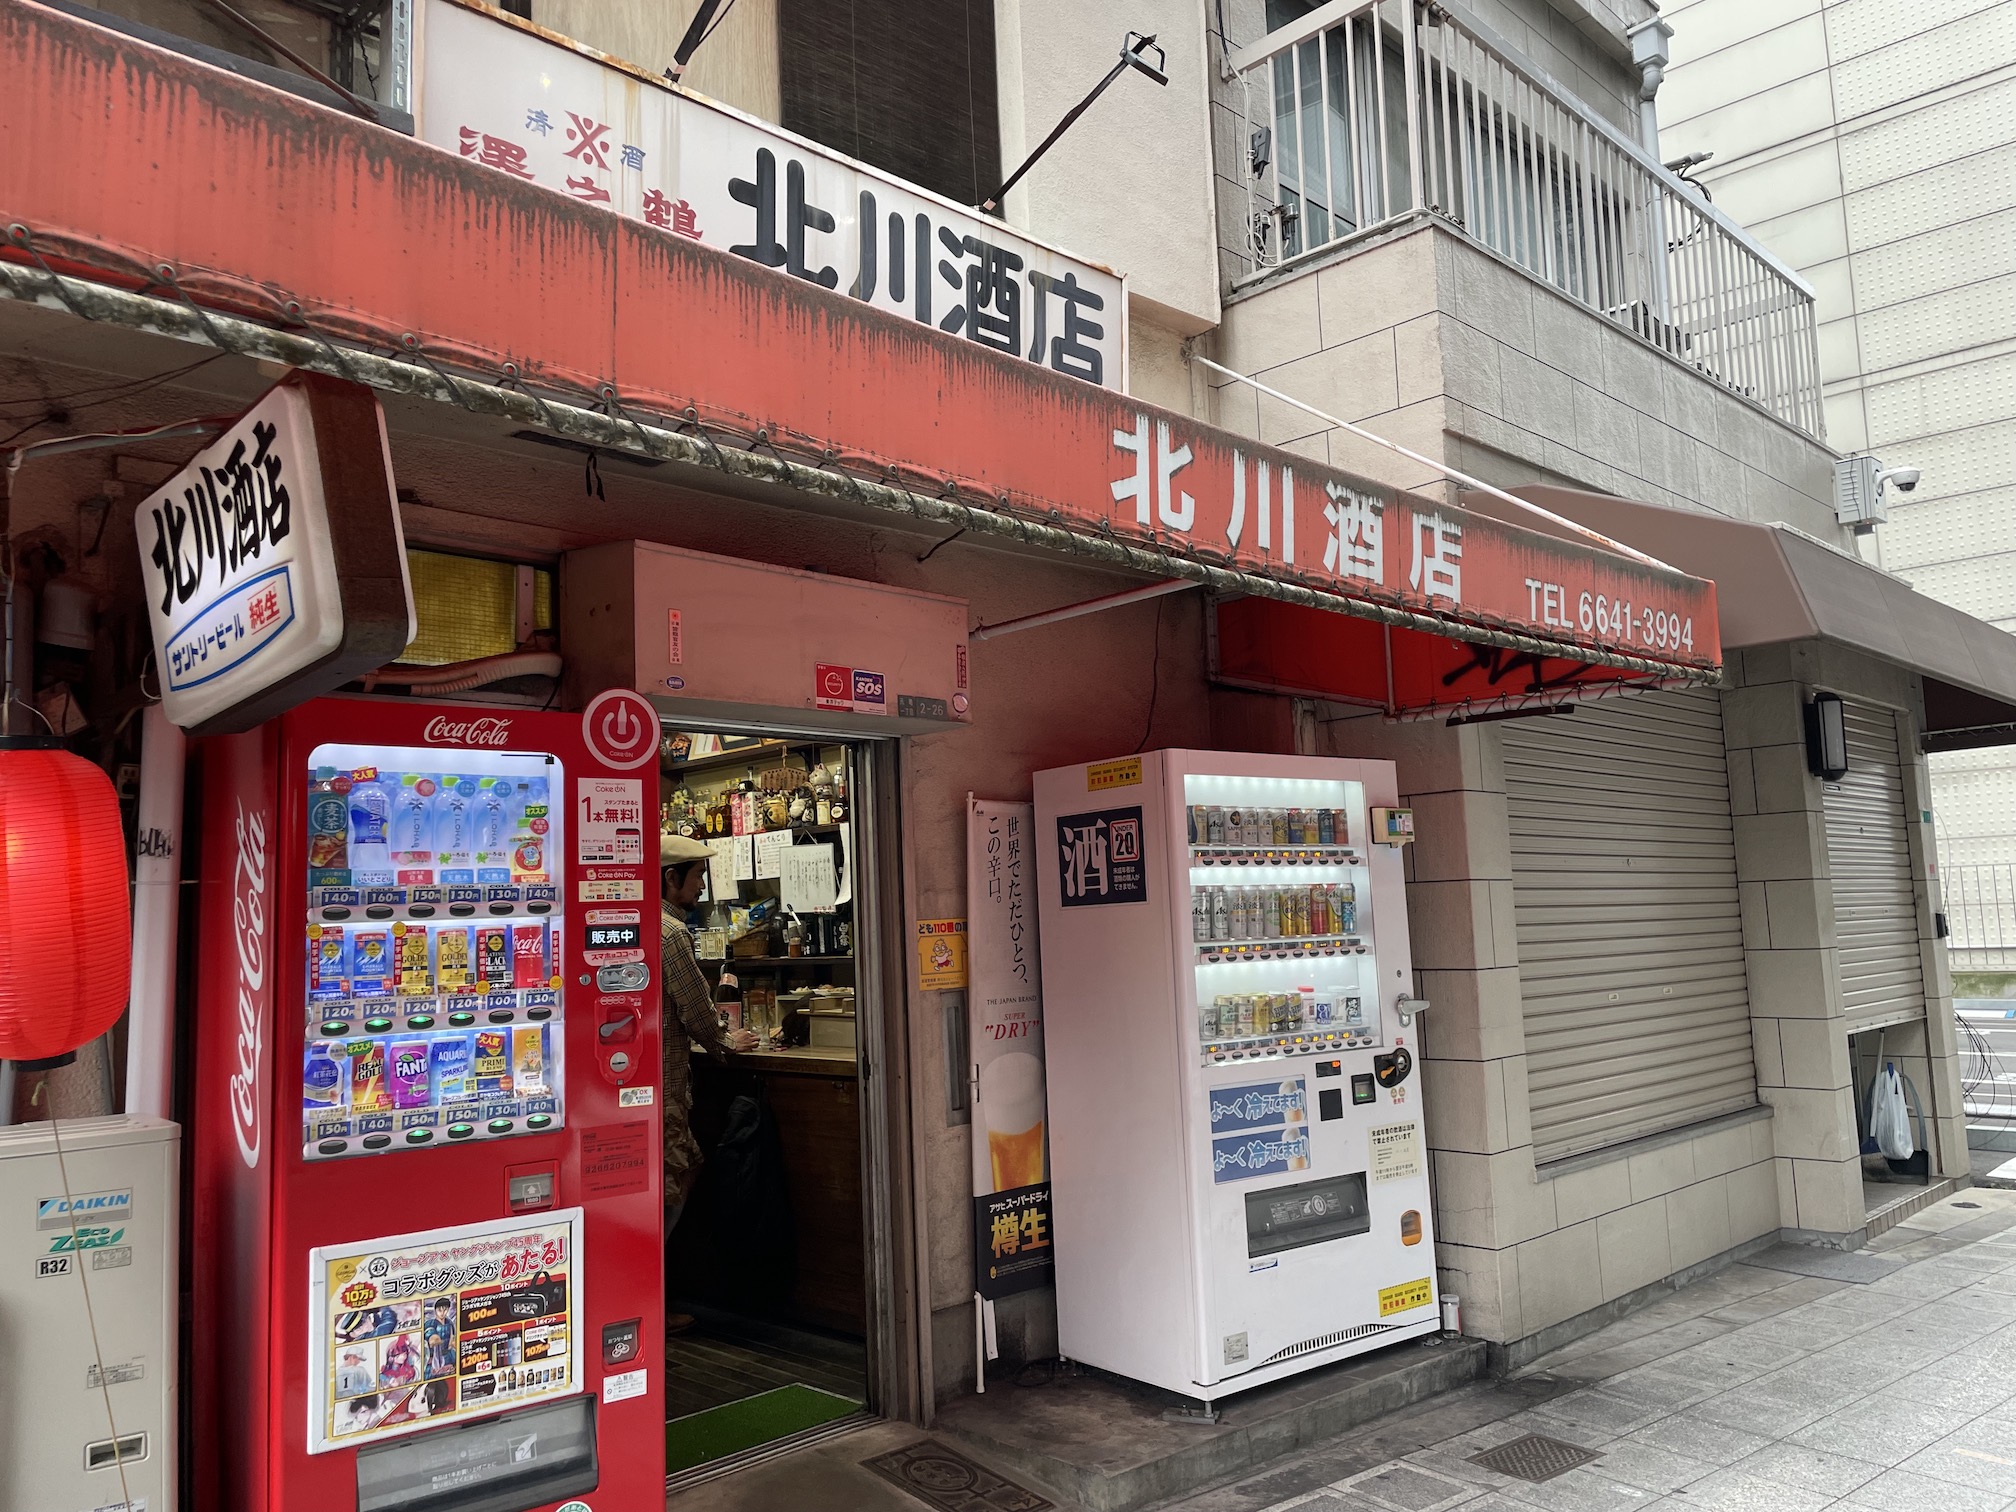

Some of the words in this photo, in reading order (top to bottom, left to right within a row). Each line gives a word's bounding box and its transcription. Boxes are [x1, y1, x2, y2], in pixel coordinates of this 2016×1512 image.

[525, 108, 554, 137] 清
[620, 143, 646, 172] 酒
[728, 147, 1104, 385] 北川酒店
[1110, 413, 1463, 604] 北川酒店
[152, 420, 290, 617] 北川酒店
[1525, 578, 1574, 630] TEL
[1578, 592, 1695, 653] 6641-3994
[171, 612, 244, 676] サントリービール
[249, 589, 280, 630] 純生
[857, 682, 883, 696] SOS
[920, 702, 944, 716] 2-26
[424, 715, 513, 746] Coca-Cola
[352, 769, 375, 781] 大人気
[595, 785, 614, 793] Coke
[324, 803, 340, 830] 麦茶
[1116, 824, 1134, 832] UNDER
[1115, 832, 1134, 856] 20
[988, 816, 1002, 904] この辛口。
[1062, 818, 1108, 898] 酒
[624, 872, 636, 880] Pay
[1113, 866, 1136, 874] 未成年者は
[1114, 882, 1138, 890] できません。
[323, 892, 356, 903] 140円
[372, 892, 398, 902] 160円
[414, 890, 440, 900] 150円
[450, 889, 478, 899] 130円
[490, 889, 518, 898] 130円
[528, 888, 554, 898] 140円
[1007, 816, 1028, 984] 世界でただひとつ、
[591, 929, 634, 945] 販売中
[231, 796, 266, 1169] Coca-Cola
[406, 1002, 436, 1012] 120円
[1004, 1012, 1026, 1020] SUPER
[478, 1034, 501, 1046] 大人気
[488, 1106, 517, 1116] 130円
[528, 1102, 552, 1112] 140円
[404, 1114, 435, 1126] 150円
[449, 1110, 478, 1120] 150円
[320, 1124, 348, 1135] 150円
[361, 1119, 392, 1130] 140円
[58, 1194, 130, 1213] DAIKIN
[989, 1190, 1048, 1214] アサヒスーパードライ
[990, 1207, 1050, 1258] 樽生
[391, 1252, 438, 1270] ジョージア
[452, 1234, 542, 1259] ヤングジャンプ45周年
[40, 1258, 68, 1276] R32
[383, 1237, 564, 1297] コラボグッズがあたる!
[501, 1282, 528, 1292] 10ポイント
[535, 1316, 557, 1326] 1ポイント
[477, 1328, 502, 1338] 5ポイント
[344, 1376, 348, 1389] 1
